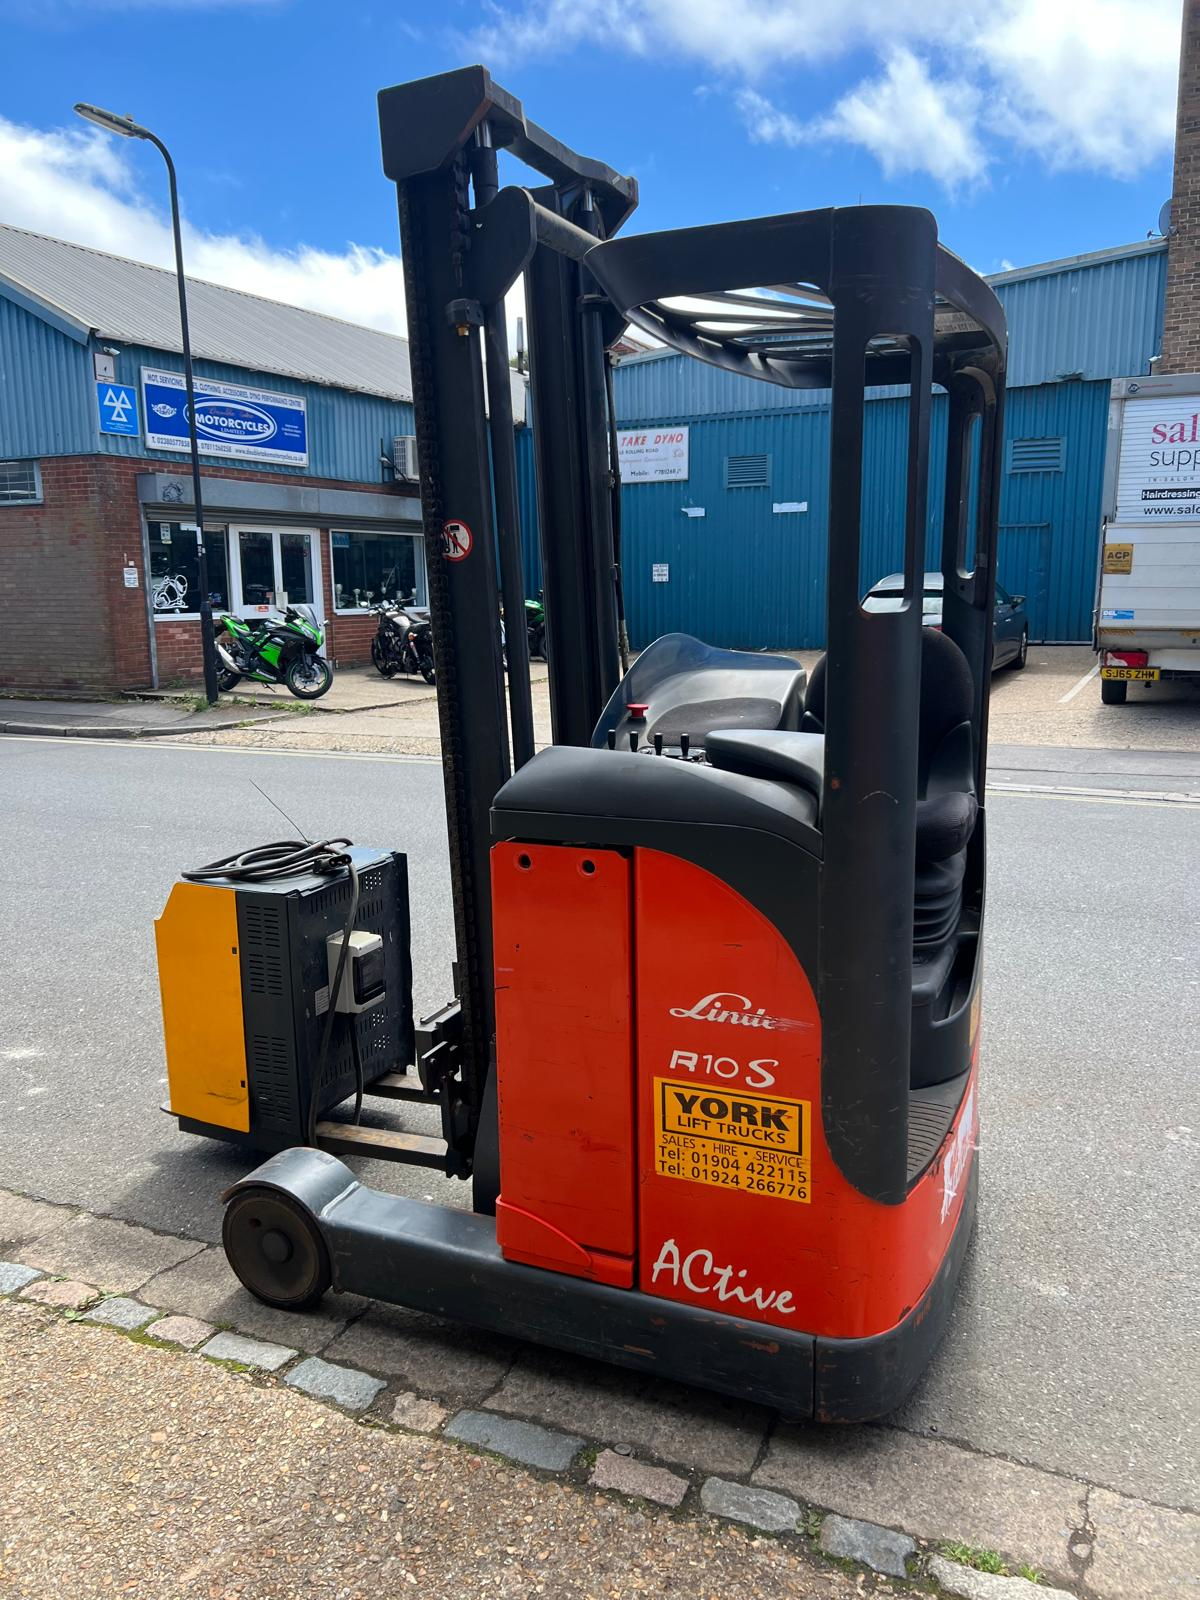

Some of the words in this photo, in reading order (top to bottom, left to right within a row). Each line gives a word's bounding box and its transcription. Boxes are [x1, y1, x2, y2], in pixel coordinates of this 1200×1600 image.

[195, 413, 269, 433] MOTORCYCLES
[220, 427, 246, 435] LIMITED
[621, 435, 648, 447] TAKE
[654, 433, 684, 444] DYNO
[1107, 551, 1130, 560] ACP
[1105, 669, 1132, 679] SJ65
[1135, 670, 1155, 680] ZHM
[669, 1050, 739, 1078] R10
[745, 1059, 779, 1088] S
[673, 1092, 790, 1131] YORK
[678, 1115, 711, 1130] LIFT
[716, 1122, 786, 1144] TRUCKS
[659, 1145, 685, 1161] Tel:
[691, 1152, 740, 1171] 01904
[746, 1162, 807, 1184] 422115
[662, 1134, 696, 1149] SALES
[713, 1143, 738, 1157] HIRE
[755, 1151, 803, 1169] SERVICE
[659, 1160, 685, 1176] Tel:
[691, 1167, 740, 1187] 01924
[746, 1176, 807, 1199] 266776
[651, 1238, 796, 1313] ACtive
